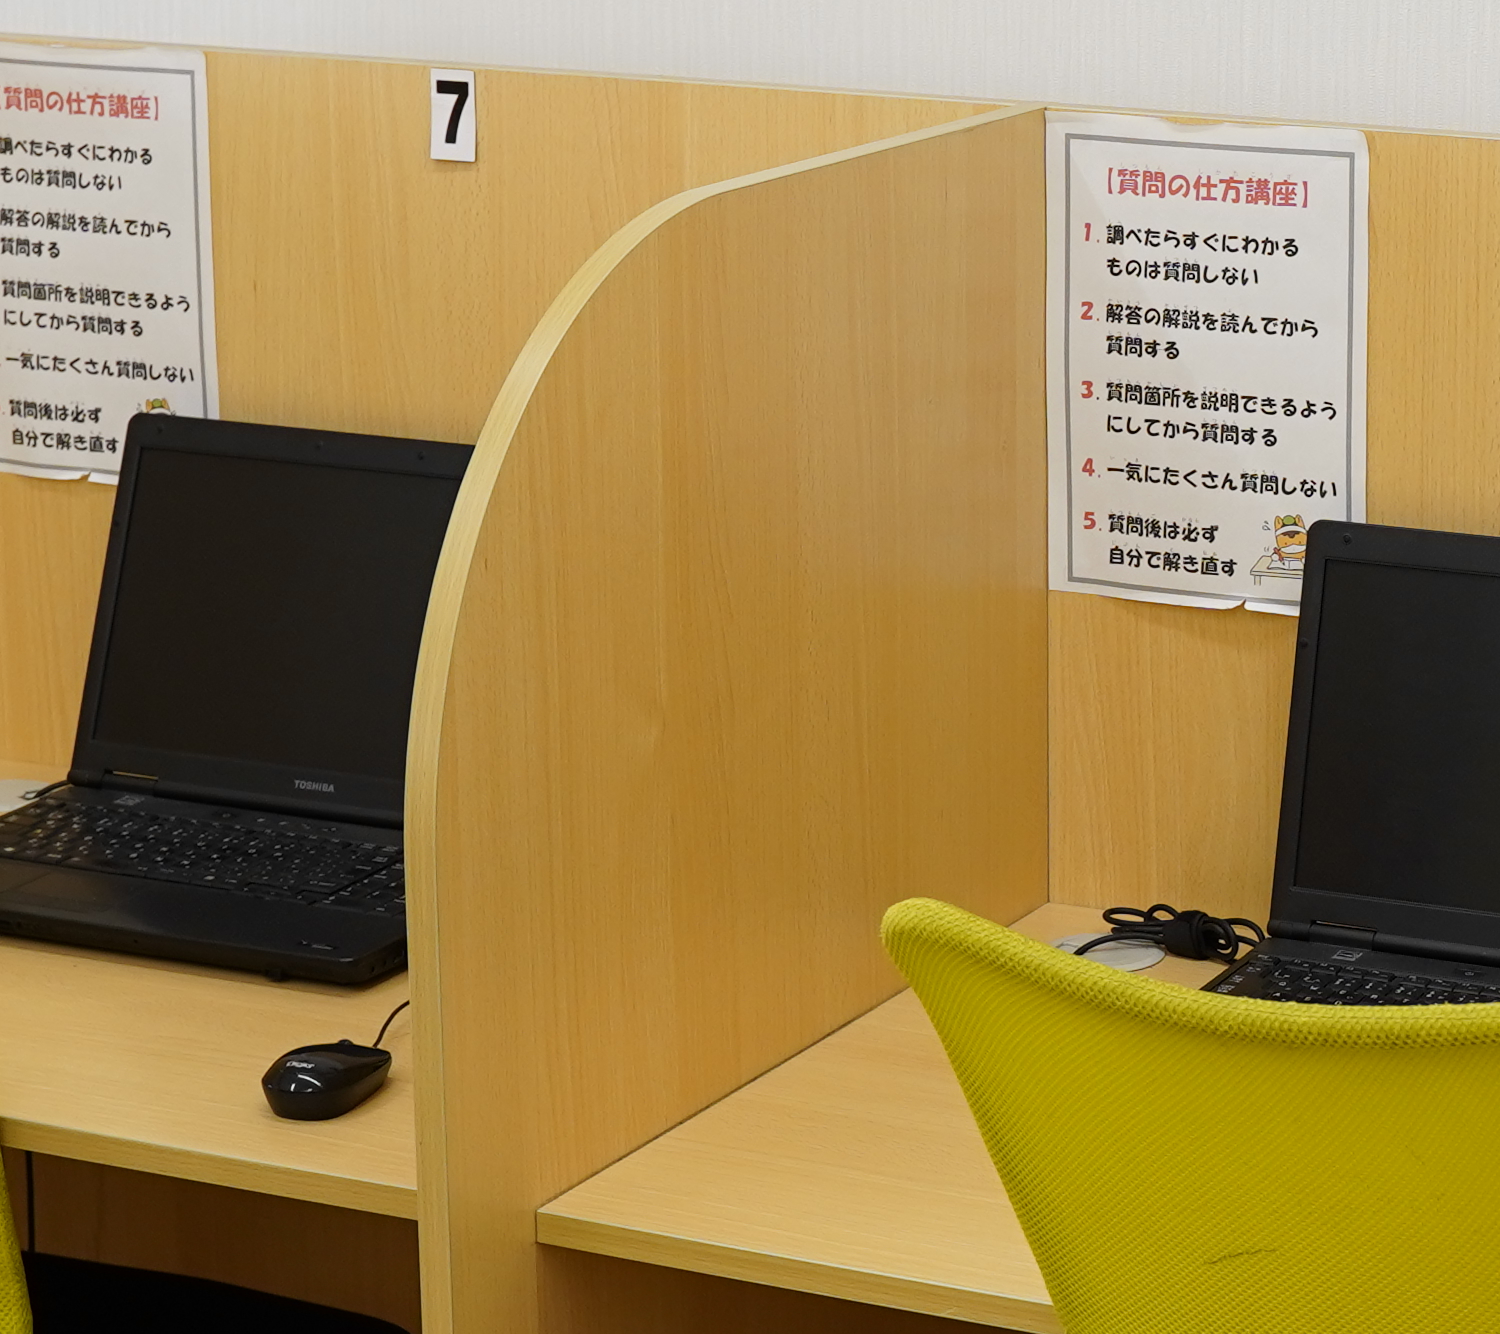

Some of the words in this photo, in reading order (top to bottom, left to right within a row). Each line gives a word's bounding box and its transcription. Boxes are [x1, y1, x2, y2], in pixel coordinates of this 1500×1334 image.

[436, 80, 468, 144] 7
[0, 166, 123, 192] ものは質問しない
[1106, 167, 1309, 208] 【質問の仕方講座】
[0, 208, 172, 239] 解答の解説を読んでから
[1083, 222, 1101, 244] 1.
[1106, 224, 1300, 257] 調べたらすぐにわかる
[0, 237, 60, 258] 質問する
[1106, 257, 1259, 286] ものは質問しない
[1, 279, 191, 313] 質問箇所を説明できるよう
[3, 309, 144, 337] にしてから質問する
[1080, 301, 1101, 322] 2.
[1105, 303, 1319, 339] 解答の解説を読んでから
[1105, 335, 1181, 360] 質問する
[5, 353, 195, 383] 一気にたくさん質問しない
[8, 400, 102, 424] 質問後は必ず
[1080, 380, 1101, 401] 3.
[1106, 381, 1338, 421] 質問箇所を説明できるよう
[12, 429, 119, 454] 自分で解き直す
[1106, 414, 1278, 448] にしてから質問する
[1081, 457, 1101, 478] 4.
[1107, 461, 1338, 499] 一気にたくさん質問しない
[1082, 511, 1102, 531] 5.
[1108, 513, 1219, 544] 質問後は必ず
[1108, 545, 1238, 578] 自分で解き直す
[294, 779, 335, 793] TOSHIBA
